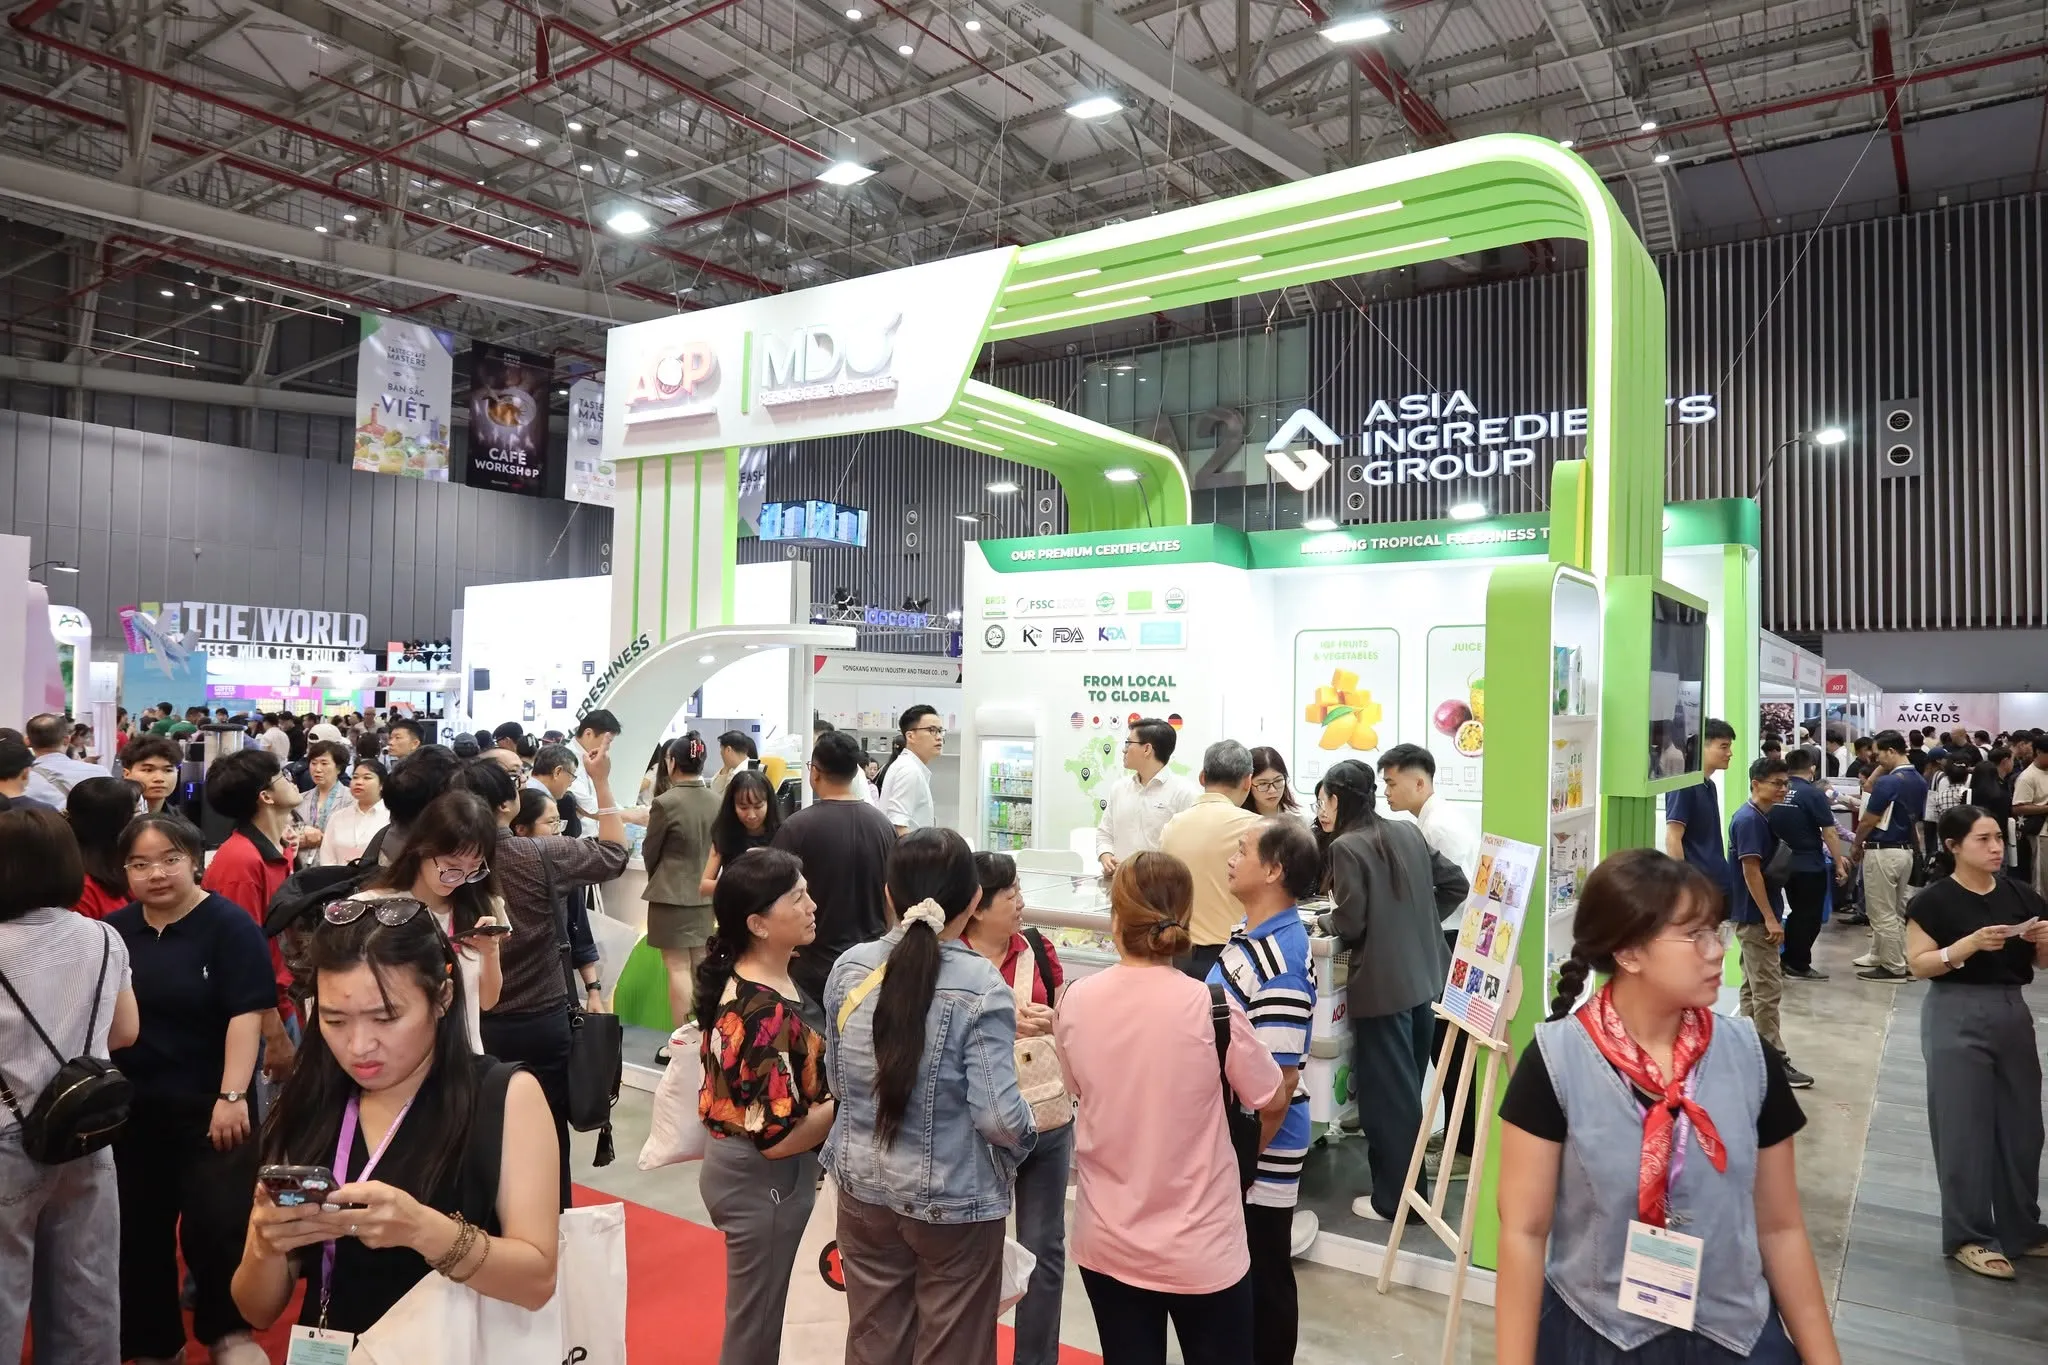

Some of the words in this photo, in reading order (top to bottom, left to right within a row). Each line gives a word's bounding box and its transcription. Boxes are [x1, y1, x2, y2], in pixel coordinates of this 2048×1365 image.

[387, 352, 426, 367] MASTERS
[381, 396, 430, 422] VIỆT
[579, 398, 604, 411] TASTE
[1364, 389, 1479, 426] ASIA
[579, 410, 604, 423] MAS
[1362, 394, 1717, 456] INGREDIES
[489, 447, 527, 465] CAFÉ
[475, 458, 540, 478] WORKSHOP
[1362, 447, 1536, 487] GROUP
[1371, 534, 1442, 549] TROPICAL
[1447, 528, 1536, 545] FRESHNESS
[1541, 527, 1550, 540] T
[1010, 549, 1036, 561] OUR
[1038, 546, 1093, 560] PREMIUM
[1095, 540, 1181, 556] CERTIFICATES
[1029, 599, 1055, 609] FSSC
[182, 601, 249, 642] THE
[256, 607, 368, 648] WORLD
[1053, 627, 1084, 643] FDA
[1338, 640, 1369, 649] FRUITS
[1452, 642, 1483, 652] JUICE
[237, 645, 274, 661] MILK
[276, 647, 298, 662] TEA
[1323, 651, 1379, 660] VEGETABLES
[575, 633, 650, 722] FRESHNESS
[1083, 675, 1124, 687] FROM
[1128, 675, 1177, 687] LOCAL
[1088, 690, 1107, 702] TO
[1111, 690, 1170, 703] GLOBAL
[1914, 703, 1943, 712] CEV
[1897, 713, 1960, 723] AWARDS
[1331, 1002, 1346, 1024] ACP
